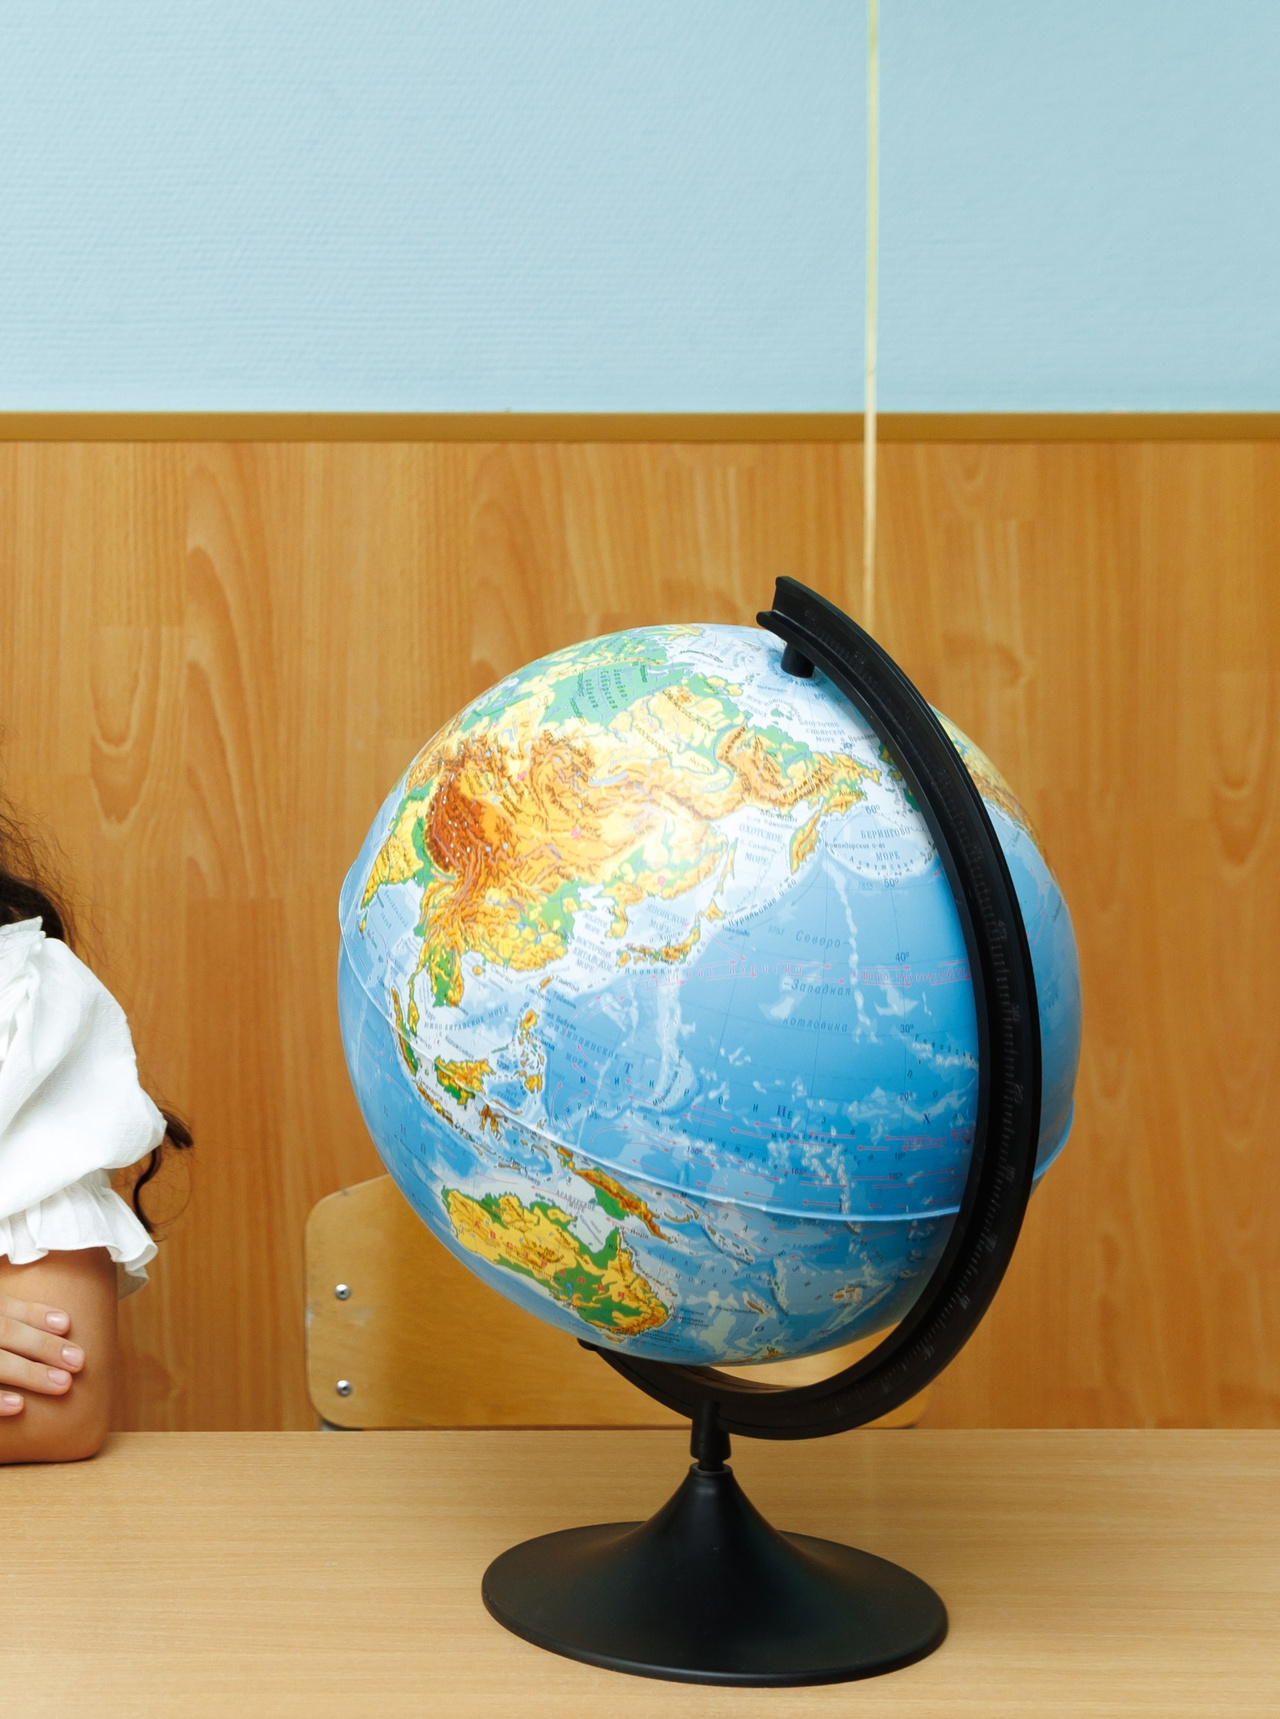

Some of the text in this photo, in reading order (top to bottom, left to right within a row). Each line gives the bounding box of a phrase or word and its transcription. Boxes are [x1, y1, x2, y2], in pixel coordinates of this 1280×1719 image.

[865, 804, 881, 815] 60°
[738, 823, 784, 844] ОХОТСКОЕ
[860, 827, 911, 840] БЕРИНГОВО
[825, 842, 869, 850] Командорские
[744, 851, 769, 866] МОРЕ
[875, 850, 900, 861] МОРЕ
[884, 877, 899, 889] 50°
[647, 904, 689, 926] ЯПОНСКОЕ
[728, 898, 777, 927] Курильские
[649, 919, 672, 933] МОРЕ
[659, 930, 684, 942] Хонсю
[795, 930, 850, 949] Северо-
[573, 946, 615, 974] КИТАЙСКОЕ
[895, 951, 910, 963] 40°
[576, 958, 596, 973] МОРЕ
[625, 967, 680, 975] Японские
[445, 1016, 484, 1031] КИТАЙСКОЕ
[783, 1017, 848, 1033] котловина
[900, 1023, 915, 1034] 30°
[547, 1021, 620, 1060] ФИЛИППИНСКОЕ
[565, 1052, 588, 1070] МОРЕ
[900, 1091, 913, 1101] 20°
[675, 1273, 719, 1288] МОРЕ
